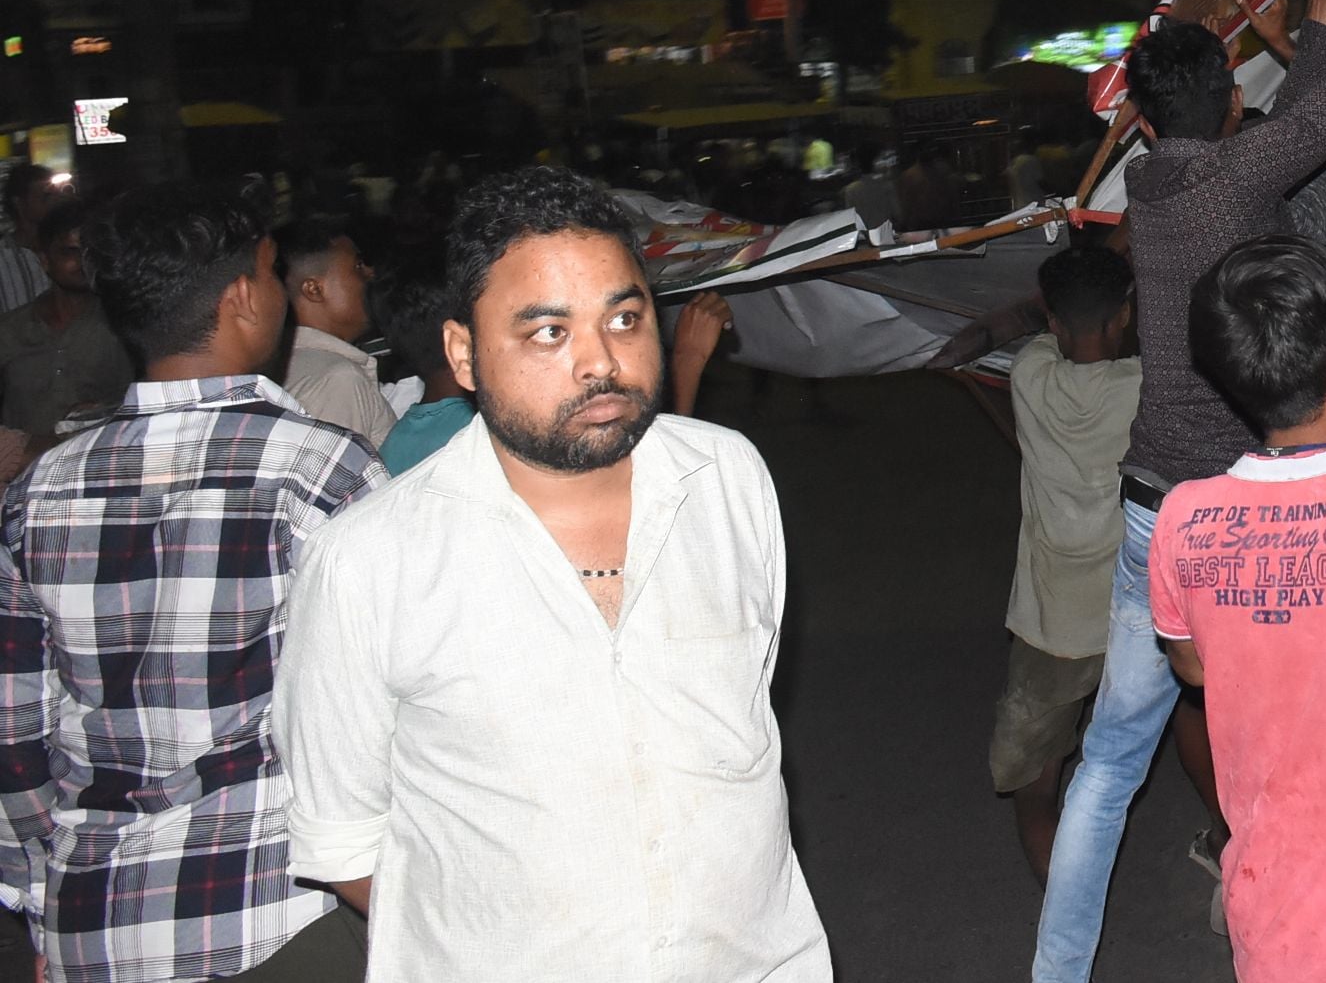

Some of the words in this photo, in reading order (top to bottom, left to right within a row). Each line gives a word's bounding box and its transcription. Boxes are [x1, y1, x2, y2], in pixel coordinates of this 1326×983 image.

[1177, 520, 1217, 550] True
[1221, 520, 1319, 558] Sporting
[1177, 555, 1245, 589] BEST
[1215, 588, 1266, 607] HIGH
[1276, 588, 1325, 607] PLAY
